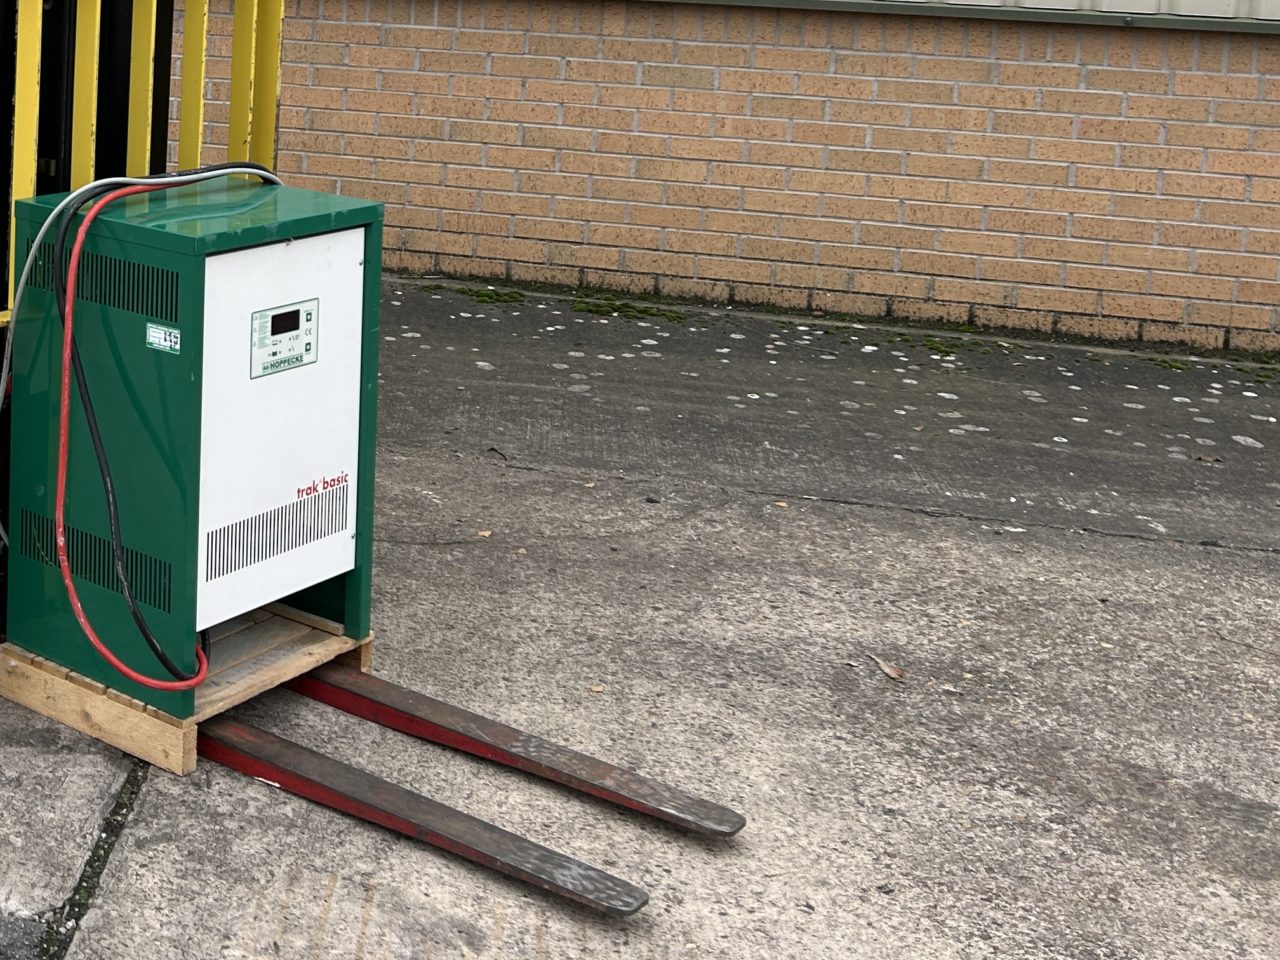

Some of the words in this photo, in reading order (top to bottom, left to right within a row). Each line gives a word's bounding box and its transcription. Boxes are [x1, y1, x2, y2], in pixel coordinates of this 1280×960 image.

[270, 355, 303, 370] HOPPECKE
[297, 480, 319, 499] trak
[322, 470, 348, 490] basic
